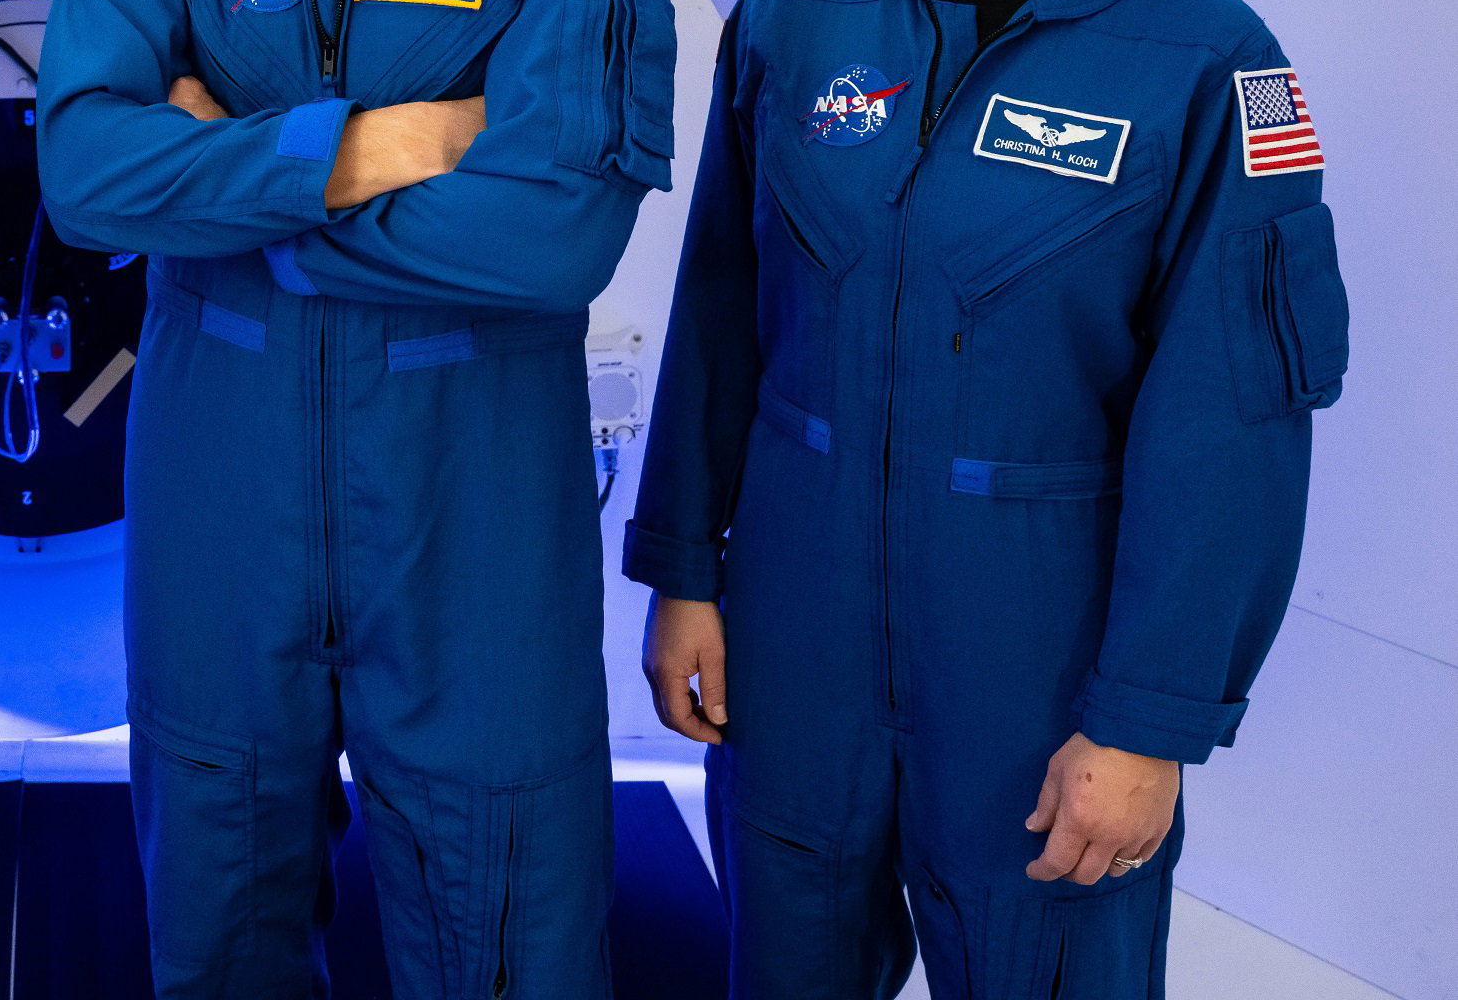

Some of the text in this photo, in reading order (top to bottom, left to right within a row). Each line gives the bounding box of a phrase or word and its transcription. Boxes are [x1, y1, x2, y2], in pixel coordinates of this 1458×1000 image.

[813, 95, 888, 119] NASA
[993, 138, 1098, 169] CHRISTINA H. KOCH
